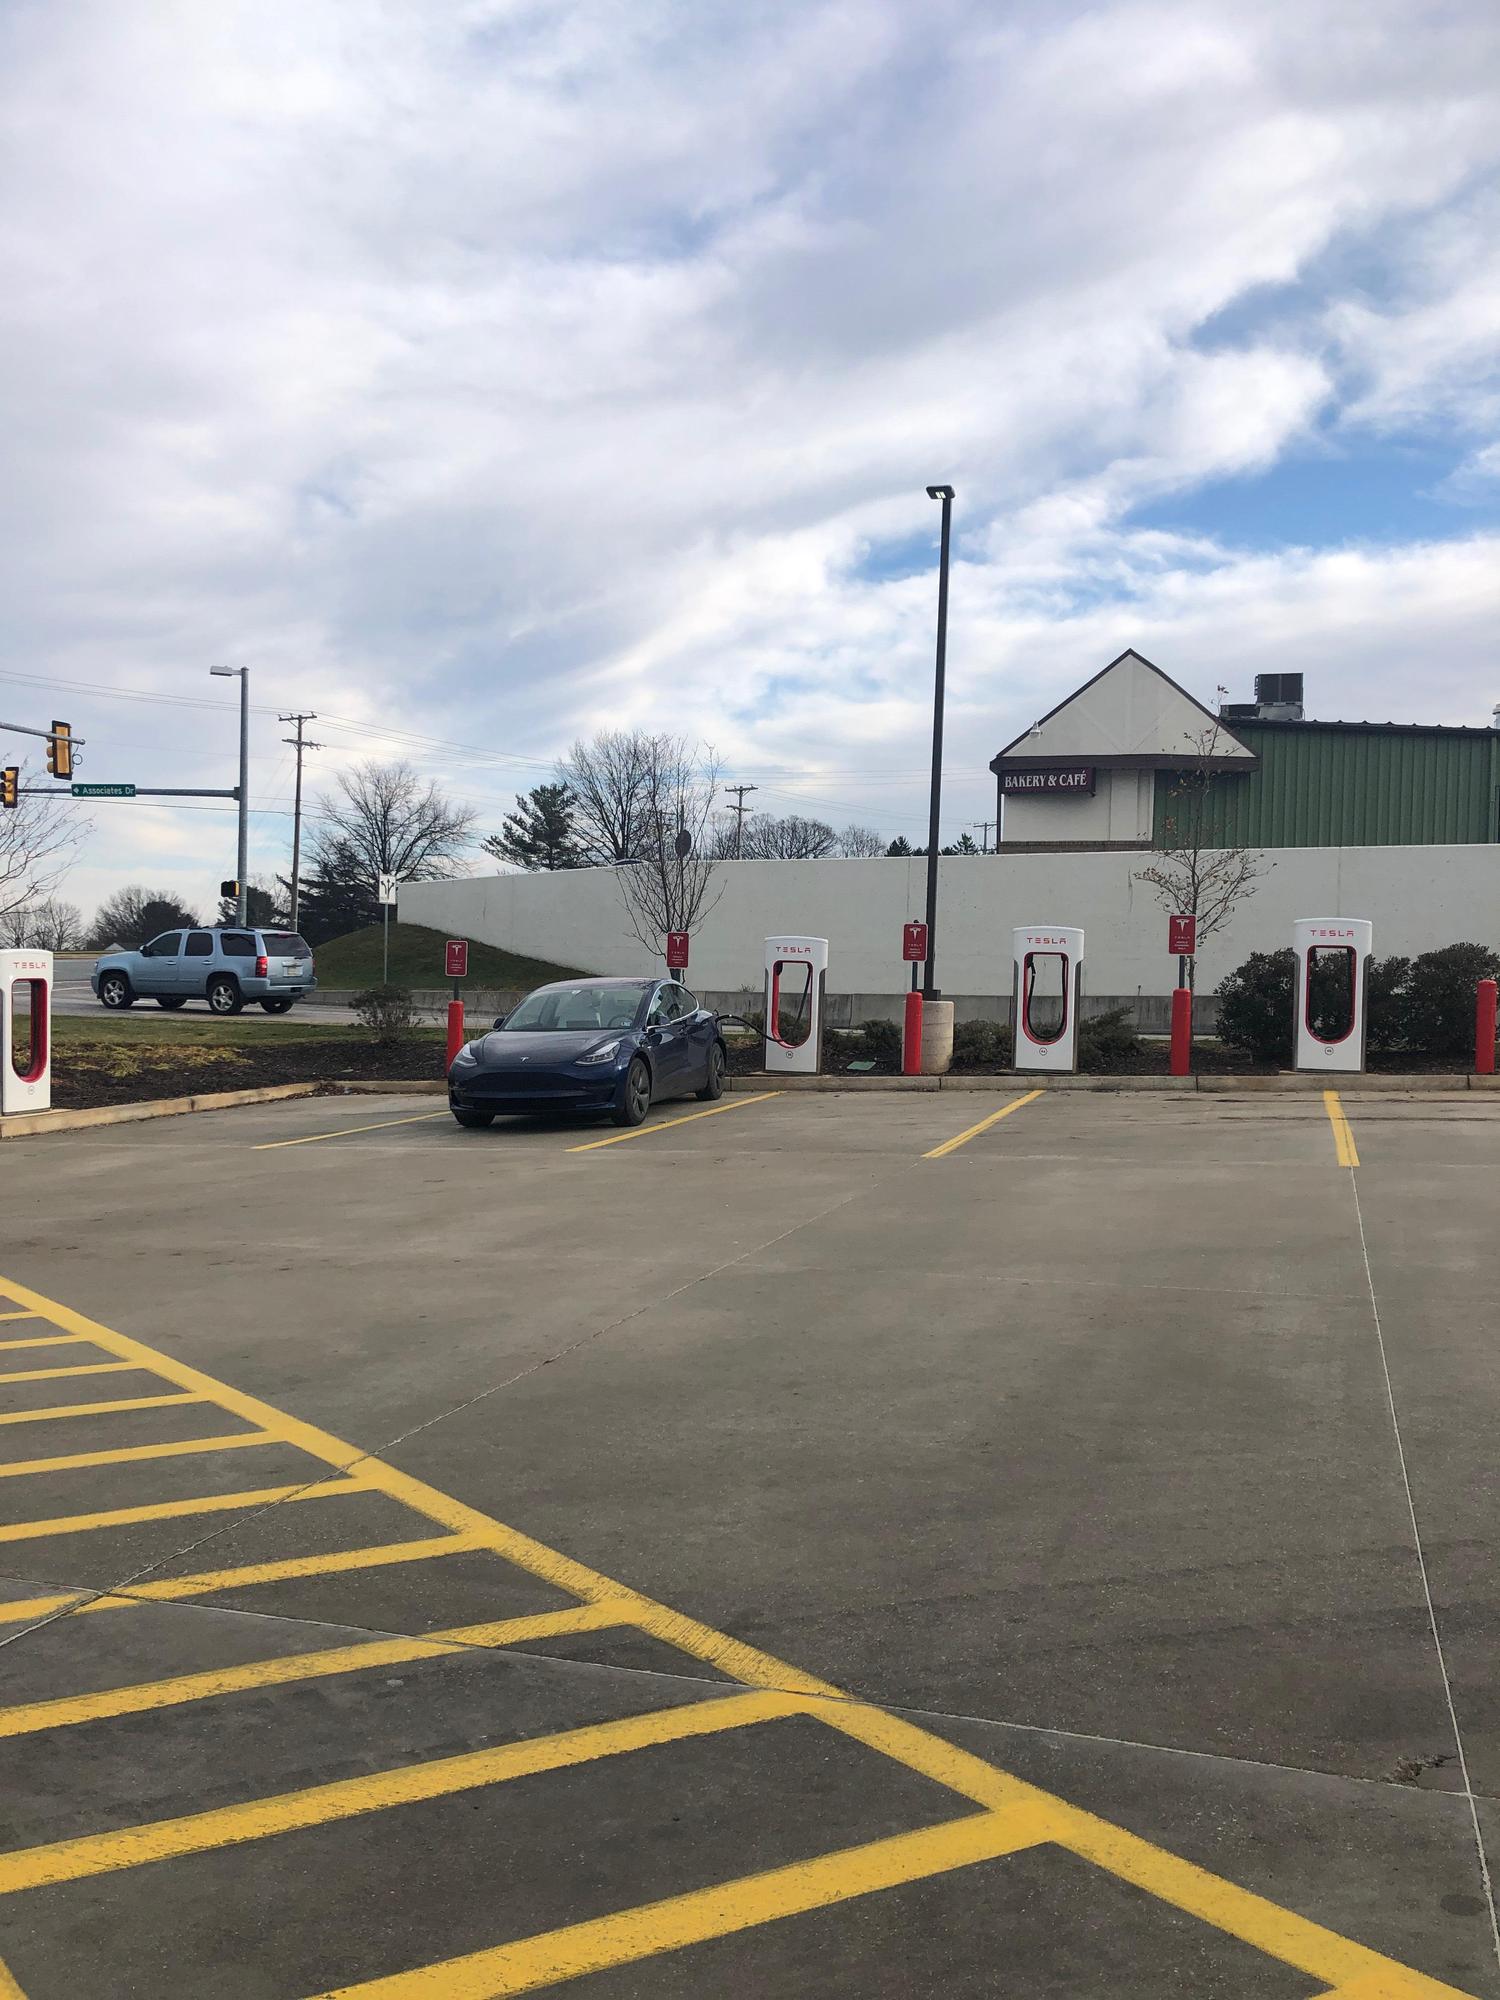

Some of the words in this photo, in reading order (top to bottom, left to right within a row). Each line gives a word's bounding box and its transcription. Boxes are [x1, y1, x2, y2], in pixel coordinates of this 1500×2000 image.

[1005, 775, 1046, 788] BAKERY
[1047, 774, 1058, 787] &
[1059, 769, 1087, 786] CAFÉ
[82, 786, 123, 795] Associates
[124, 786, 135, 795] Dr
[1309, 929, 1354, 937] TESLA
[1026, 937, 1067, 945] TESLA
[775, 946, 811, 954] TESLA
[12, 961, 47, 969] TESLA
